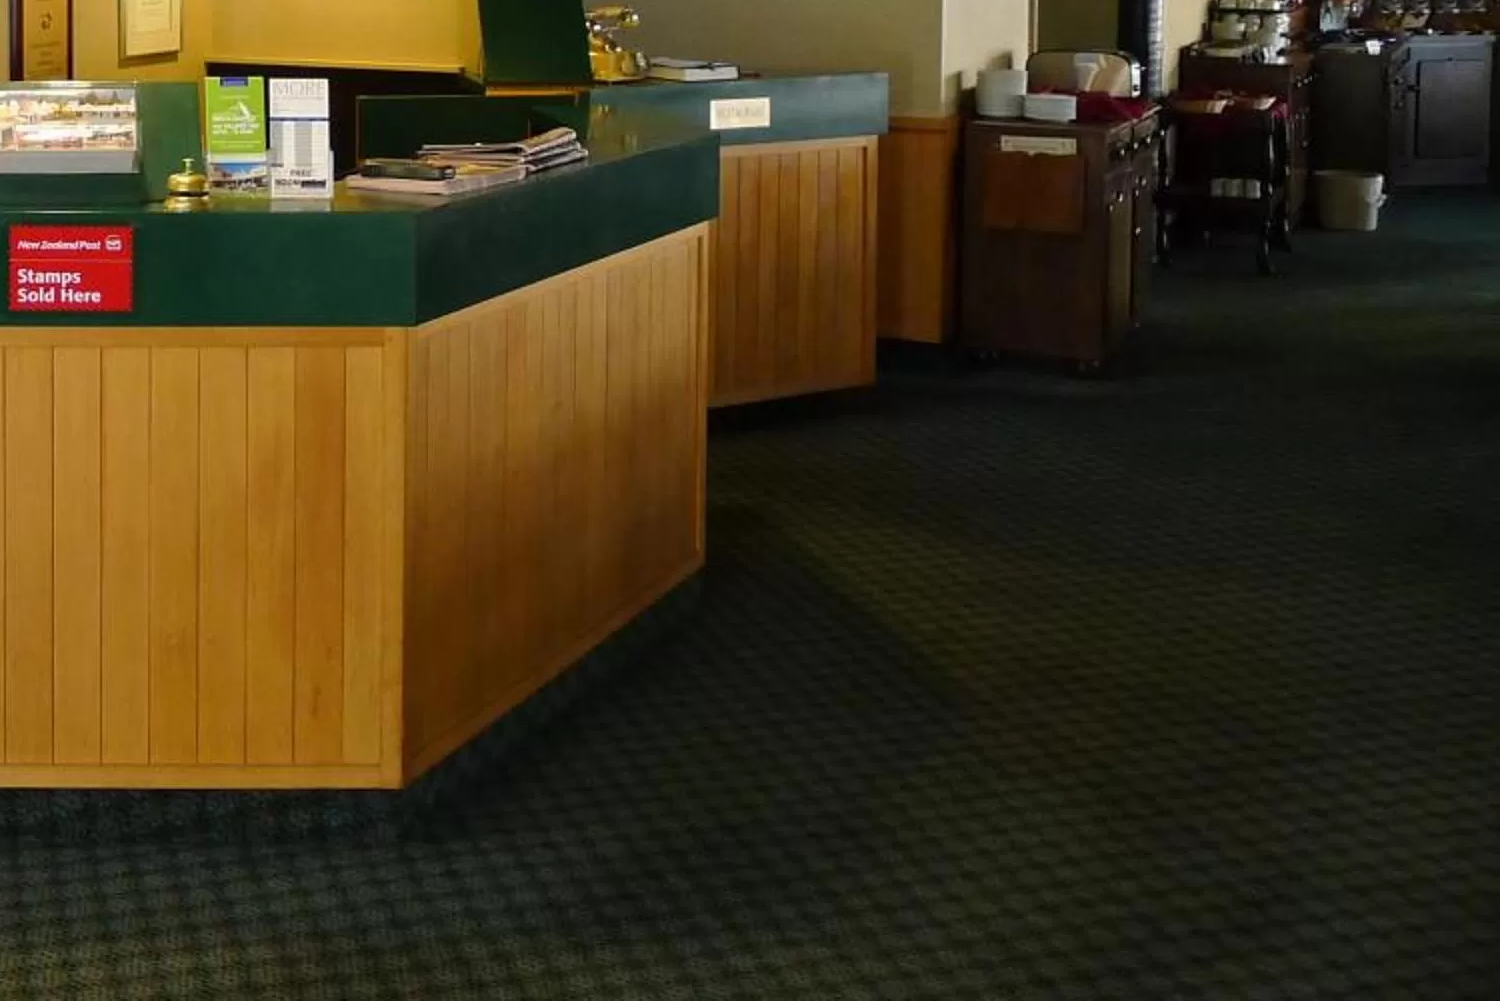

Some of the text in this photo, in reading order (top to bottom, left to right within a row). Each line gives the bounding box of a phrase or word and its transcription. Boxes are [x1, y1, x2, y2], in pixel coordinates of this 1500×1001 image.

[17, 239, 101, 250] New Zealand Post
[16, 268, 82, 286] Stamps
[16, 287, 101, 303] Sold Here
